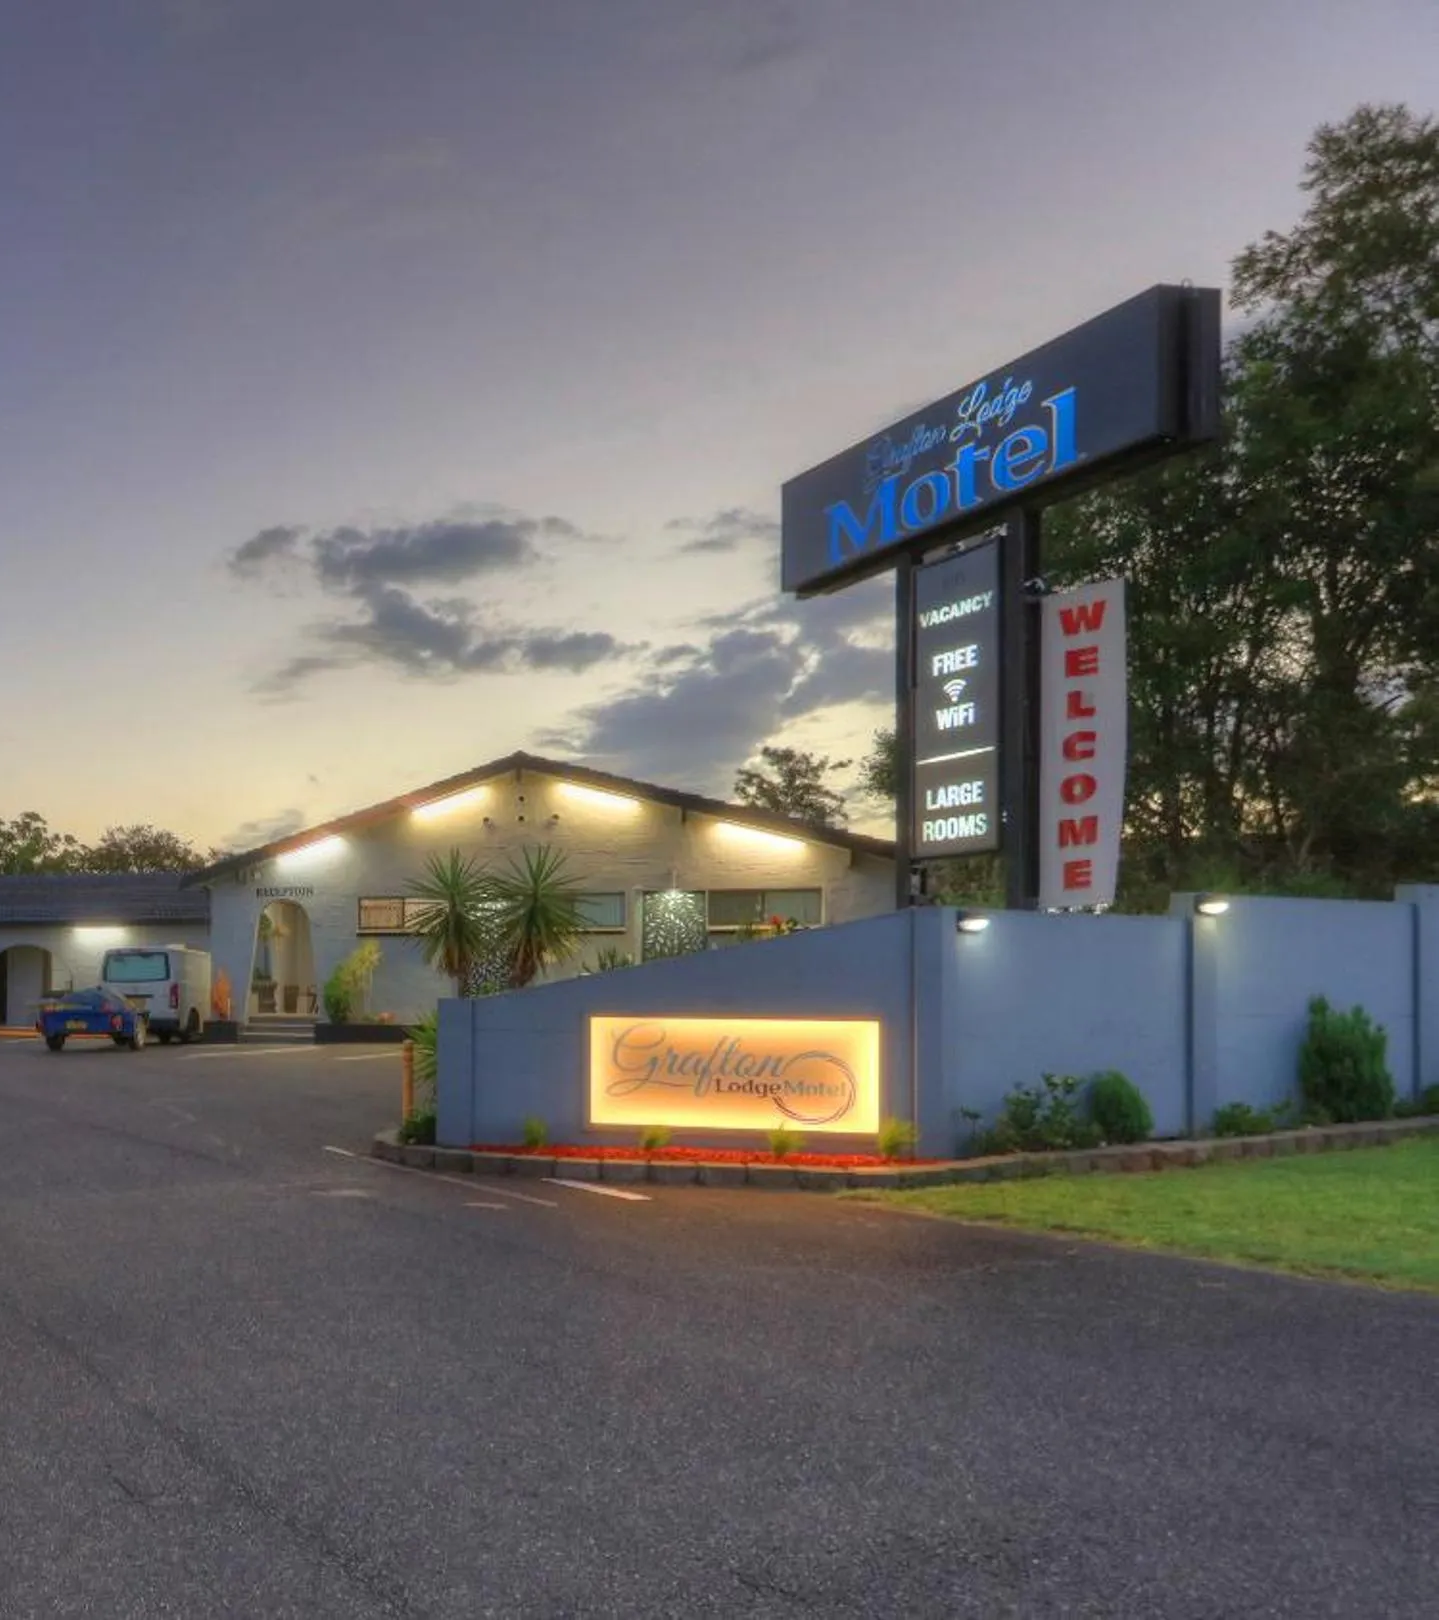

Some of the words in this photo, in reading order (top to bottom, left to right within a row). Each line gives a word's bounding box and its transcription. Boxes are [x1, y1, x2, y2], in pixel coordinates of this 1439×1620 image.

[824, 386, 1077, 568] Motel
[919, 590, 993, 628] VACANCY
[932, 644, 978, 677] FREE
[936, 702, 976, 730] WiFi
[1059, 600, 1107, 892] WELCOME
[926, 780, 983, 810] LARGE
[922, 812, 988, 842] ROOMS
[605, 1023, 785, 1098] Grafton
